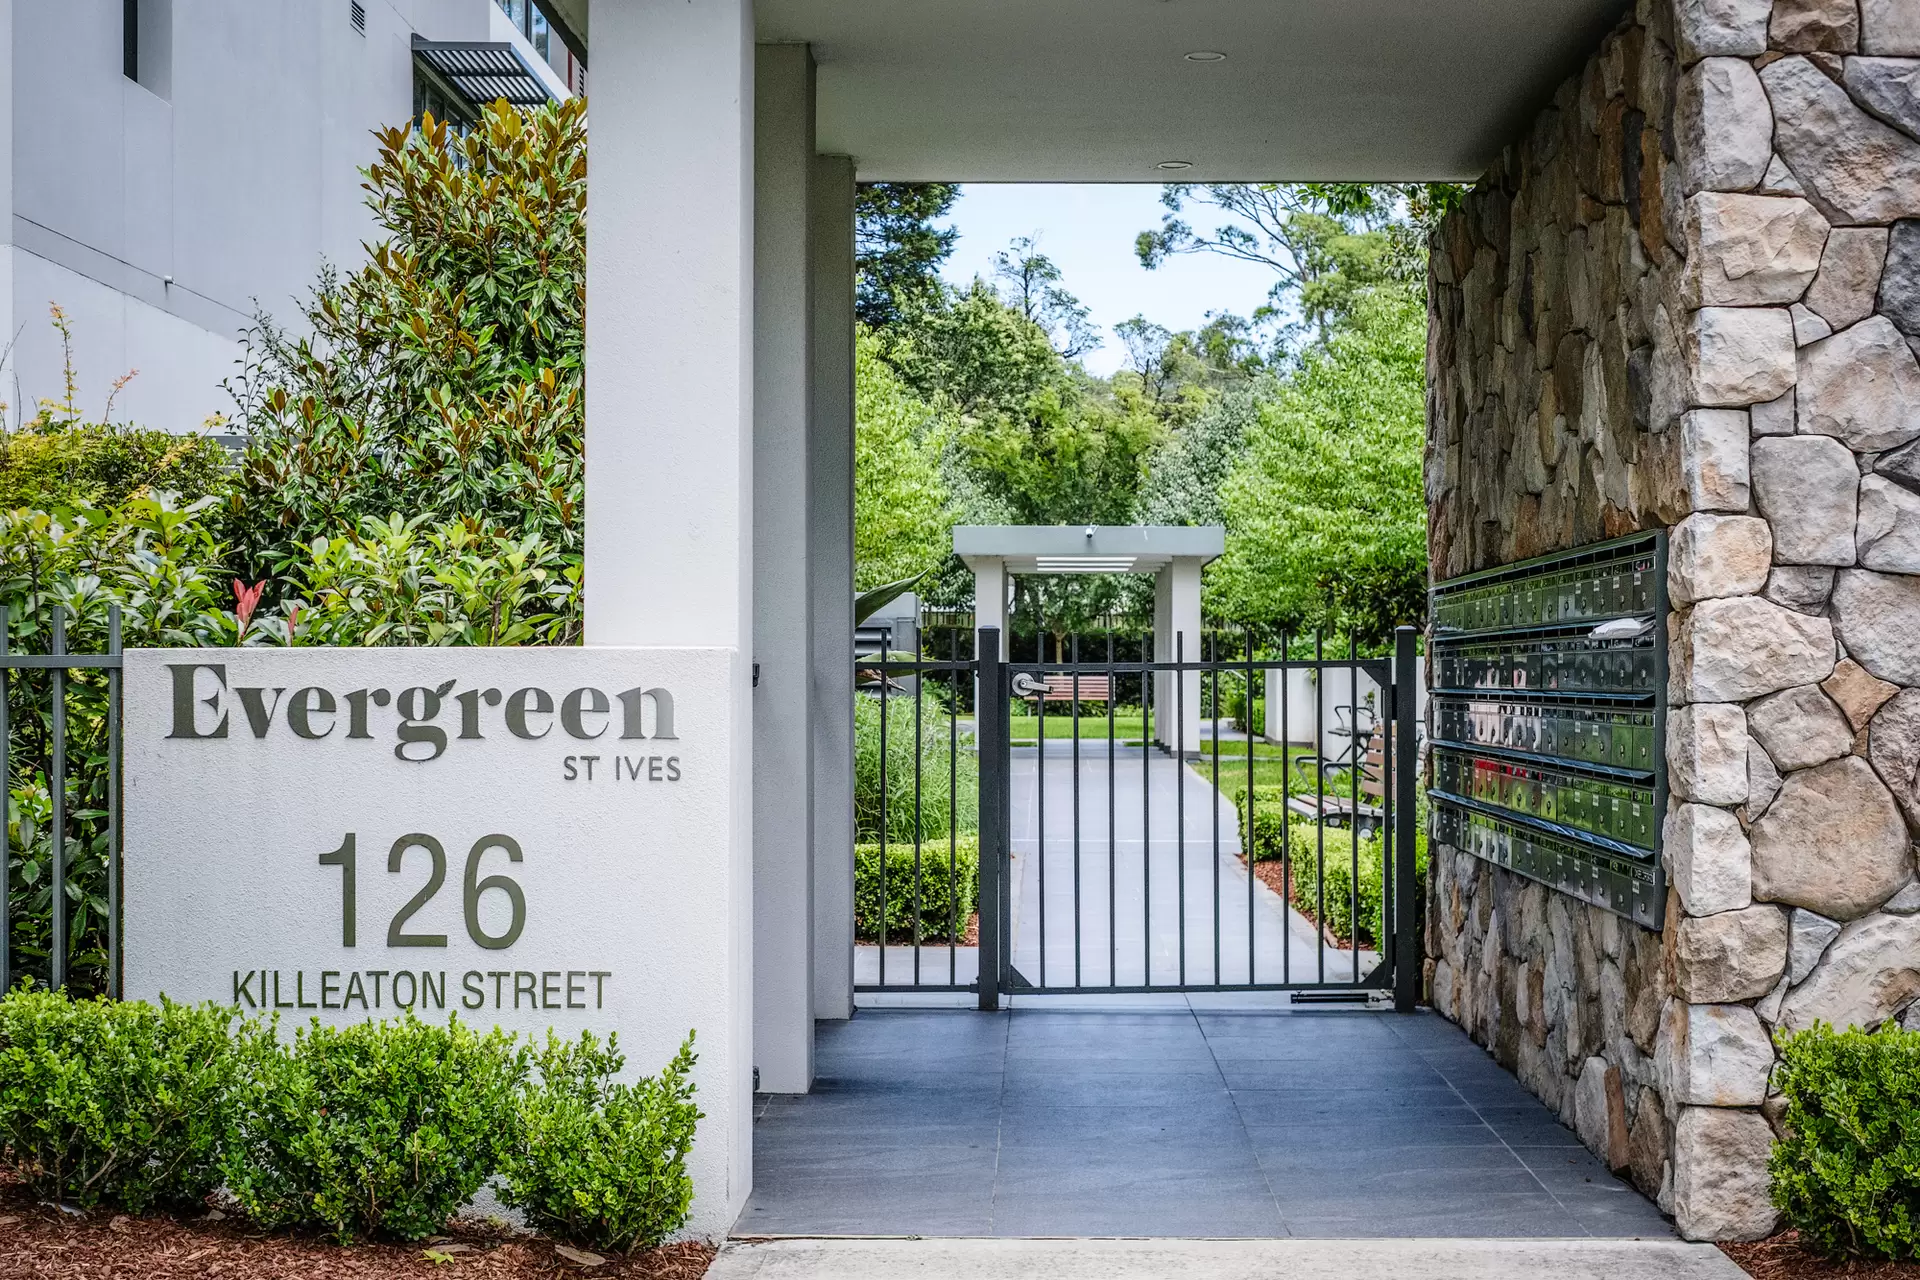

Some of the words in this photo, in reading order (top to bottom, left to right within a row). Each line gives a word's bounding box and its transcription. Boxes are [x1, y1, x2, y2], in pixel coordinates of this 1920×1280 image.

[164, 663, 680, 763] Evergreen
[563, 755, 600, 781] ST
[615, 755, 682, 782] IVES
[319, 832, 527, 950] 126
[232, 969, 446, 1010] KILLEATON
[462, 970, 613, 1010] STREET
